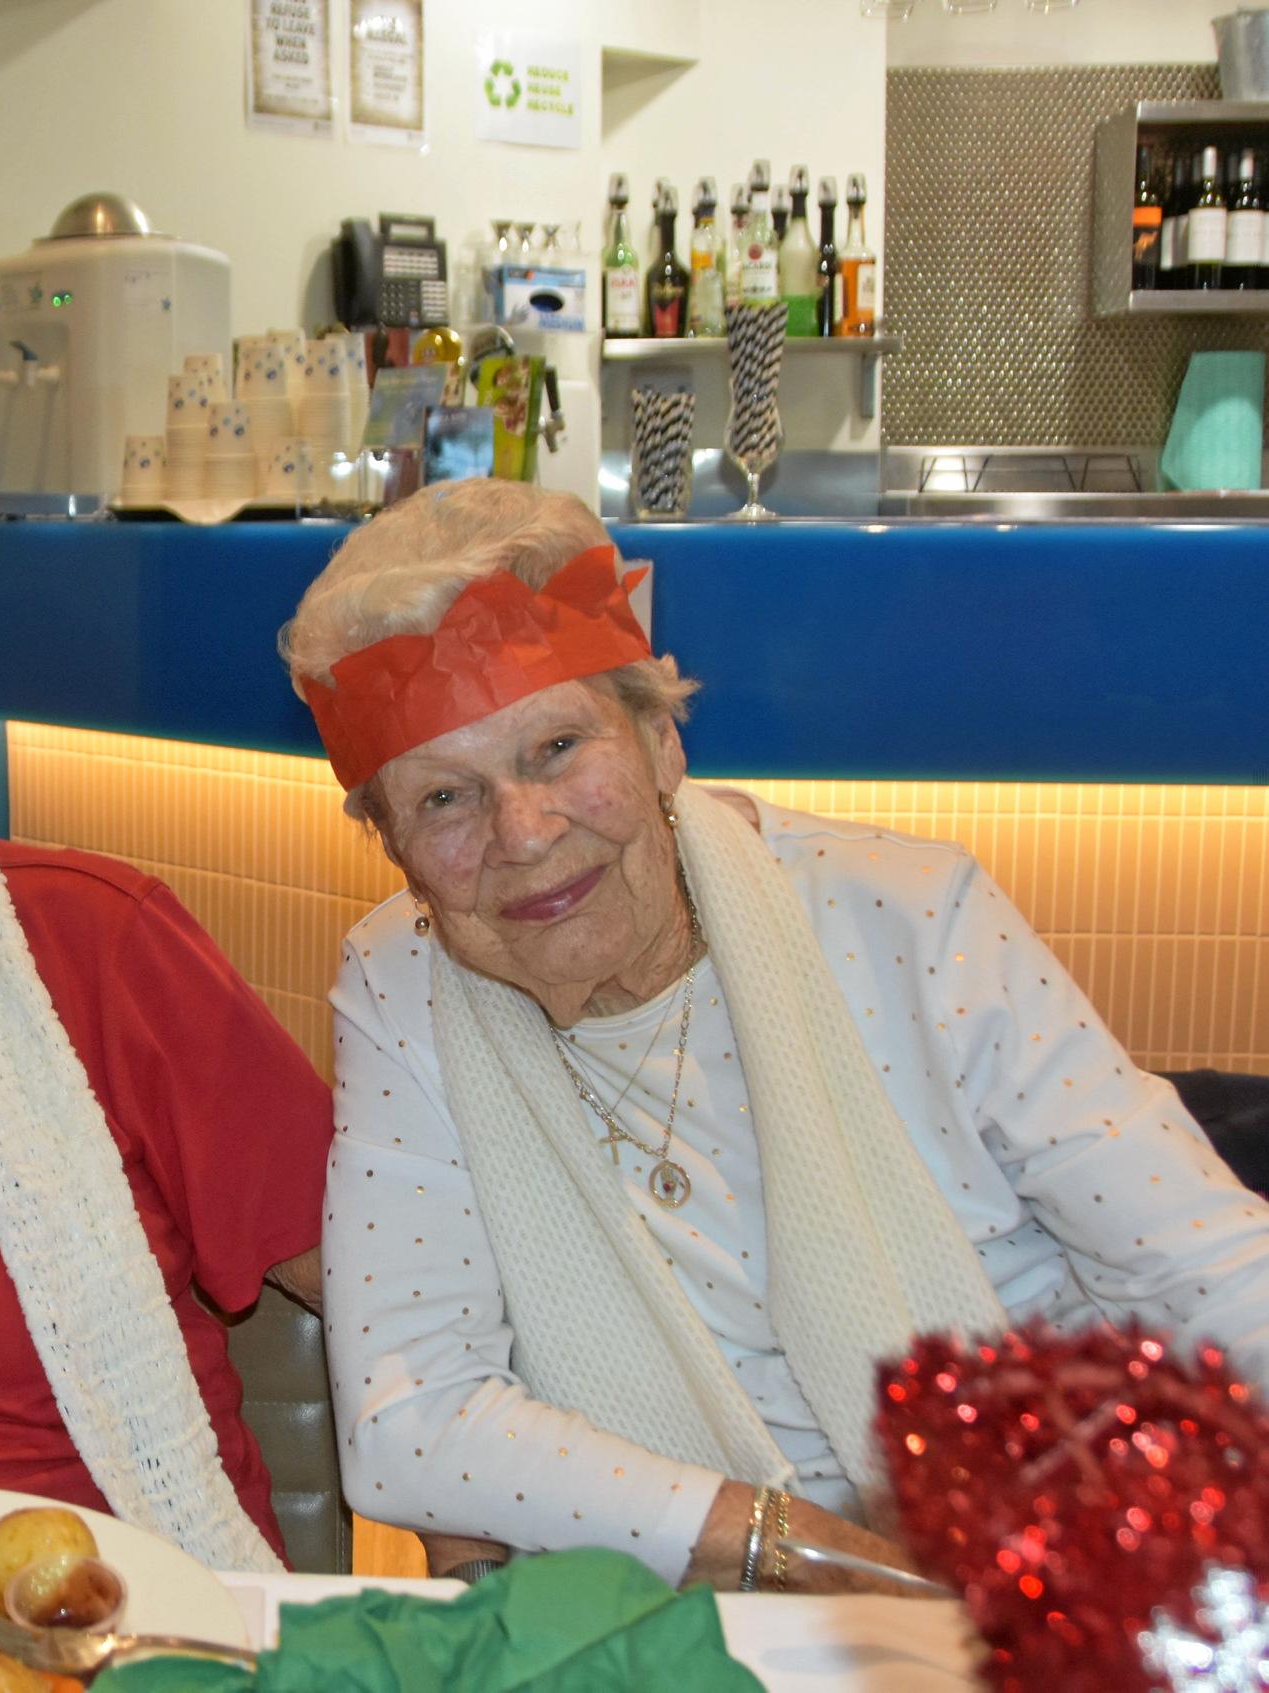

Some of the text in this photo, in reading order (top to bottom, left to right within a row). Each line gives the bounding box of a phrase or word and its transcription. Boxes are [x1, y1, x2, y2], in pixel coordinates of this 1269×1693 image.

[527, 65, 569, 81] REDUCE
[527, 81, 561, 97] REUSE
[527, 98, 573, 115] RECYCLE
